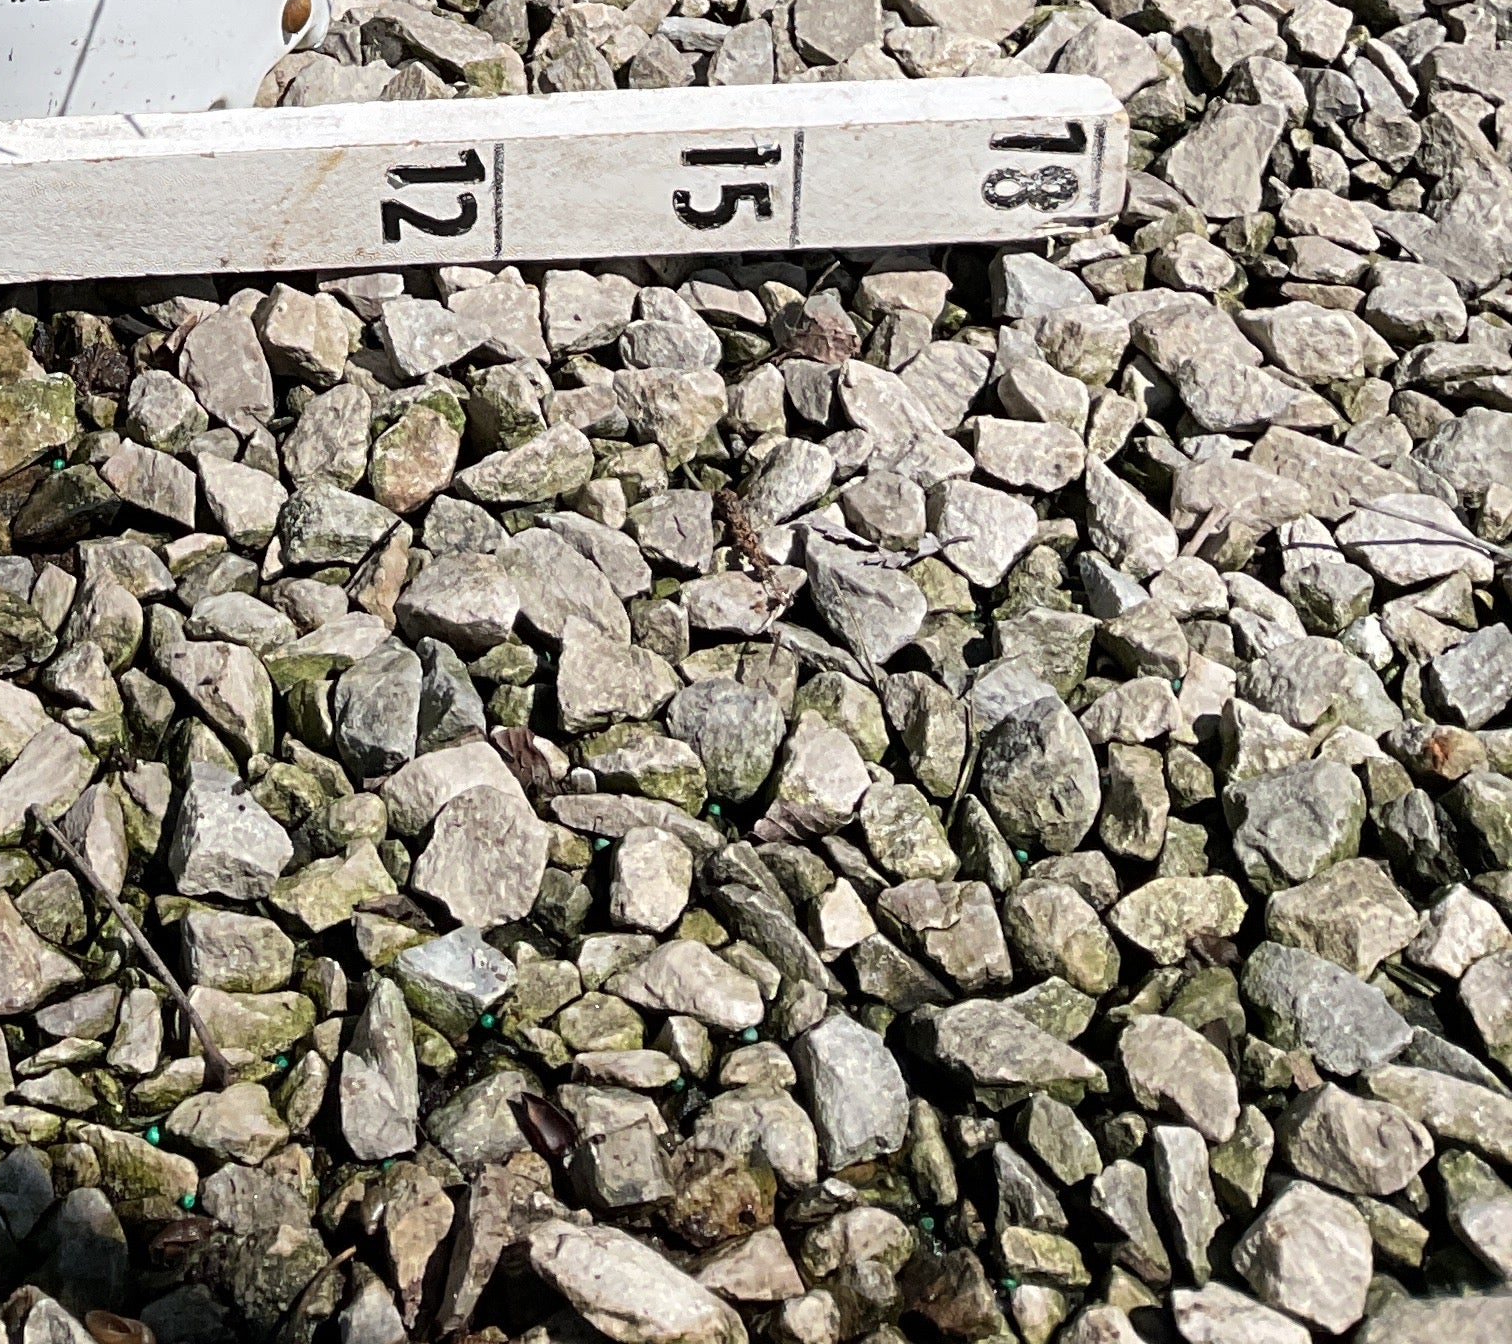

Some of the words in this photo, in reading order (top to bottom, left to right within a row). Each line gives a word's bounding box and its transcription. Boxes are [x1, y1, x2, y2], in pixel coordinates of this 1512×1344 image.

[381, 147, 486, 245] 12
[672, 143, 782, 231] 15
[980, 119, 1088, 214] 18
